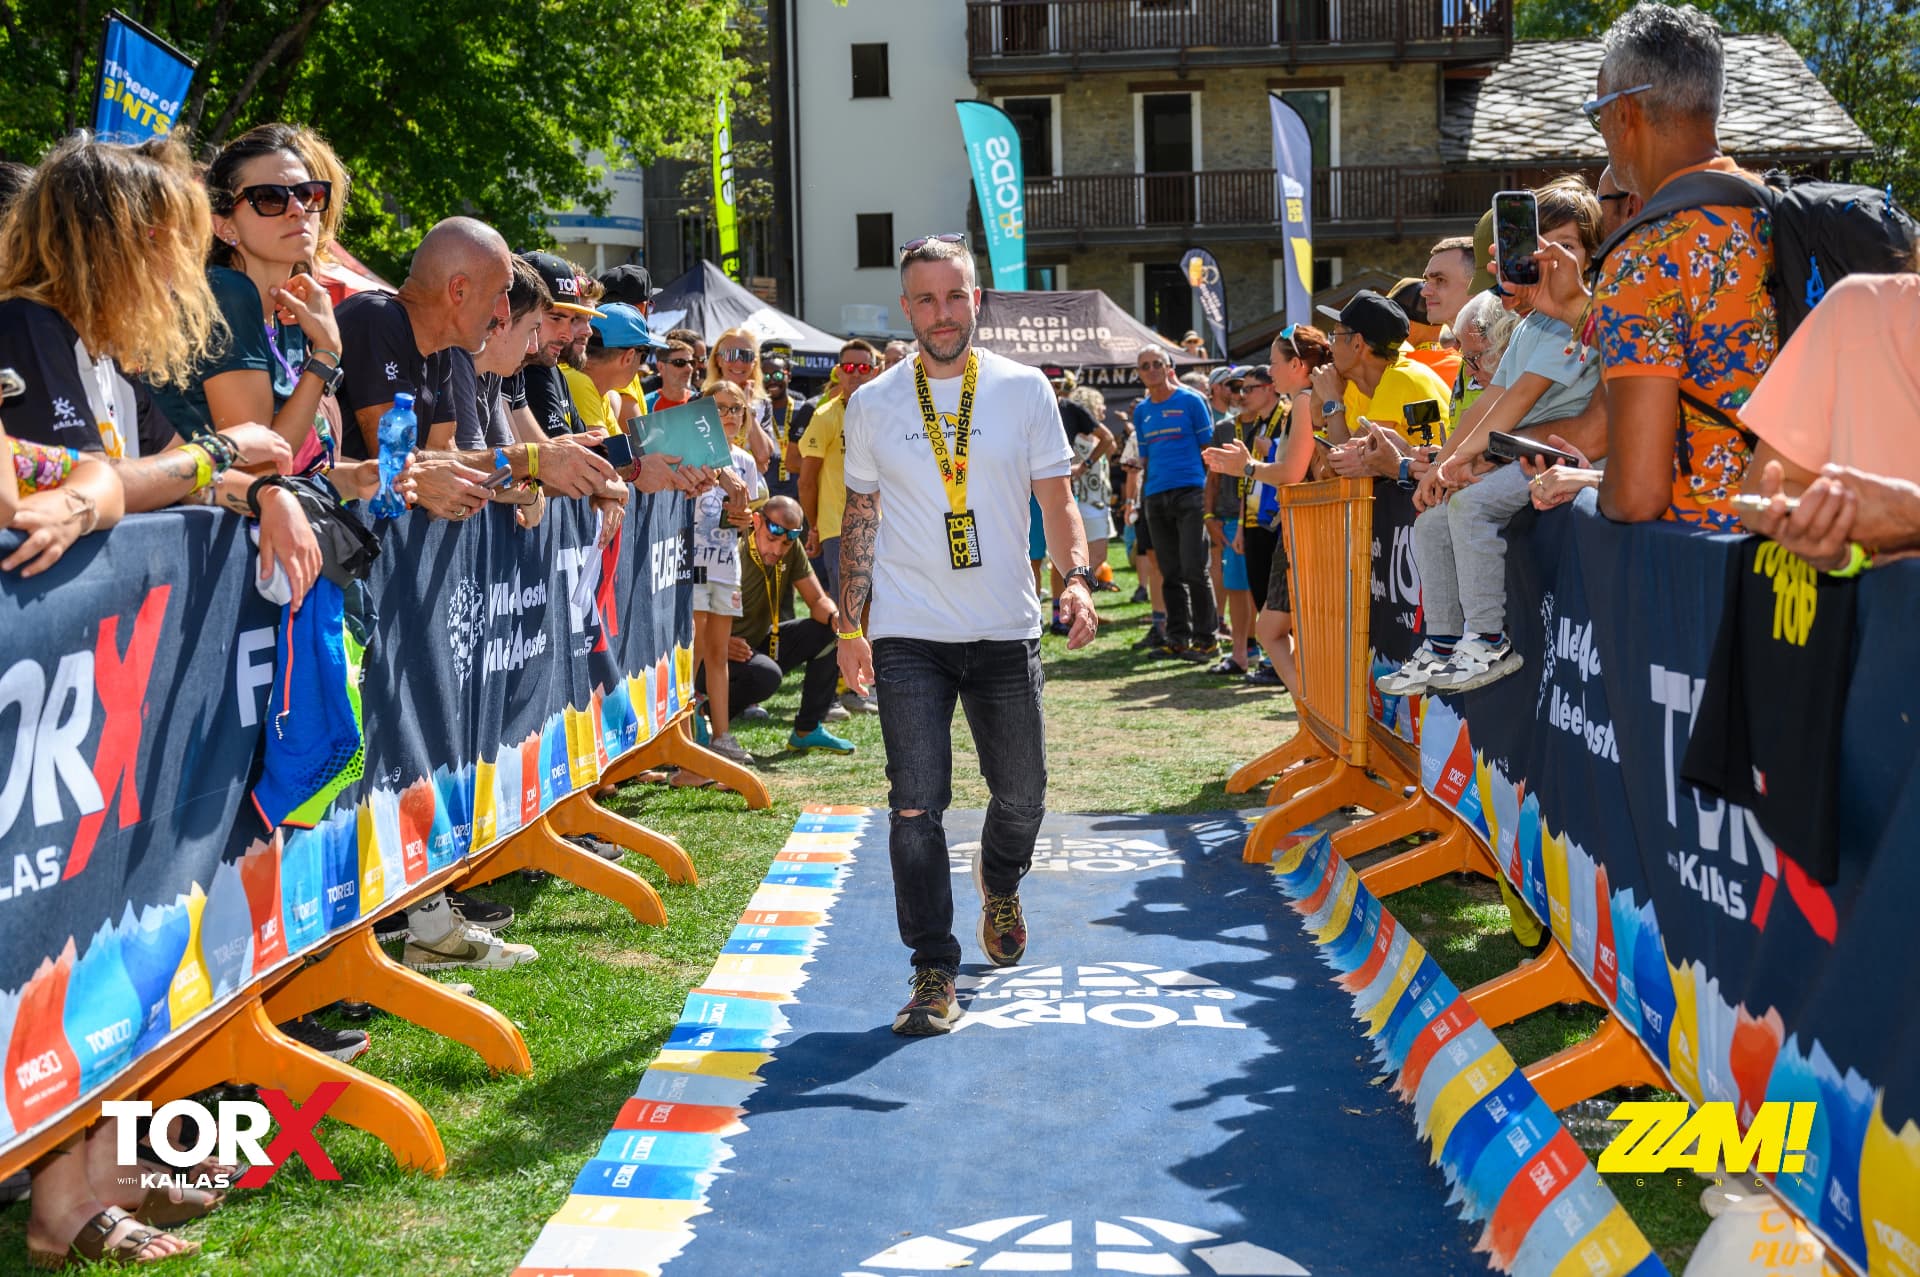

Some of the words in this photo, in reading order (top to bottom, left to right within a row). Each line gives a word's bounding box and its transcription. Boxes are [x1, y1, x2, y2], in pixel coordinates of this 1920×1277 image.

[160, 99, 179, 116] of
[978, 326, 1111, 342] BIRRIFICIO
[1018, 316, 1068, 328] AGRI
[1015, 342, 1078, 352] LEONI
[963, 360, 979, 392] 2026
[915, 362, 937, 423] FINISHER
[926, 422, 947, 456] 2026
[53, 418, 86, 431] KAILAS
[956, 390, 974, 457] FINISHER
[905, 433, 919, 441] LA
[955, 461, 966, 486] TORX
[947, 516, 973, 529] TOR
[965, 525, 980, 564] FINISHER
[326, 879, 355, 904] TOR130
[955, 986, 1238, 1002] experienc
[84, 1017, 131, 1055] TOR100
[15, 1049, 63, 1091] TOR30
[1749, 1240, 1816, 1268] PLUS
